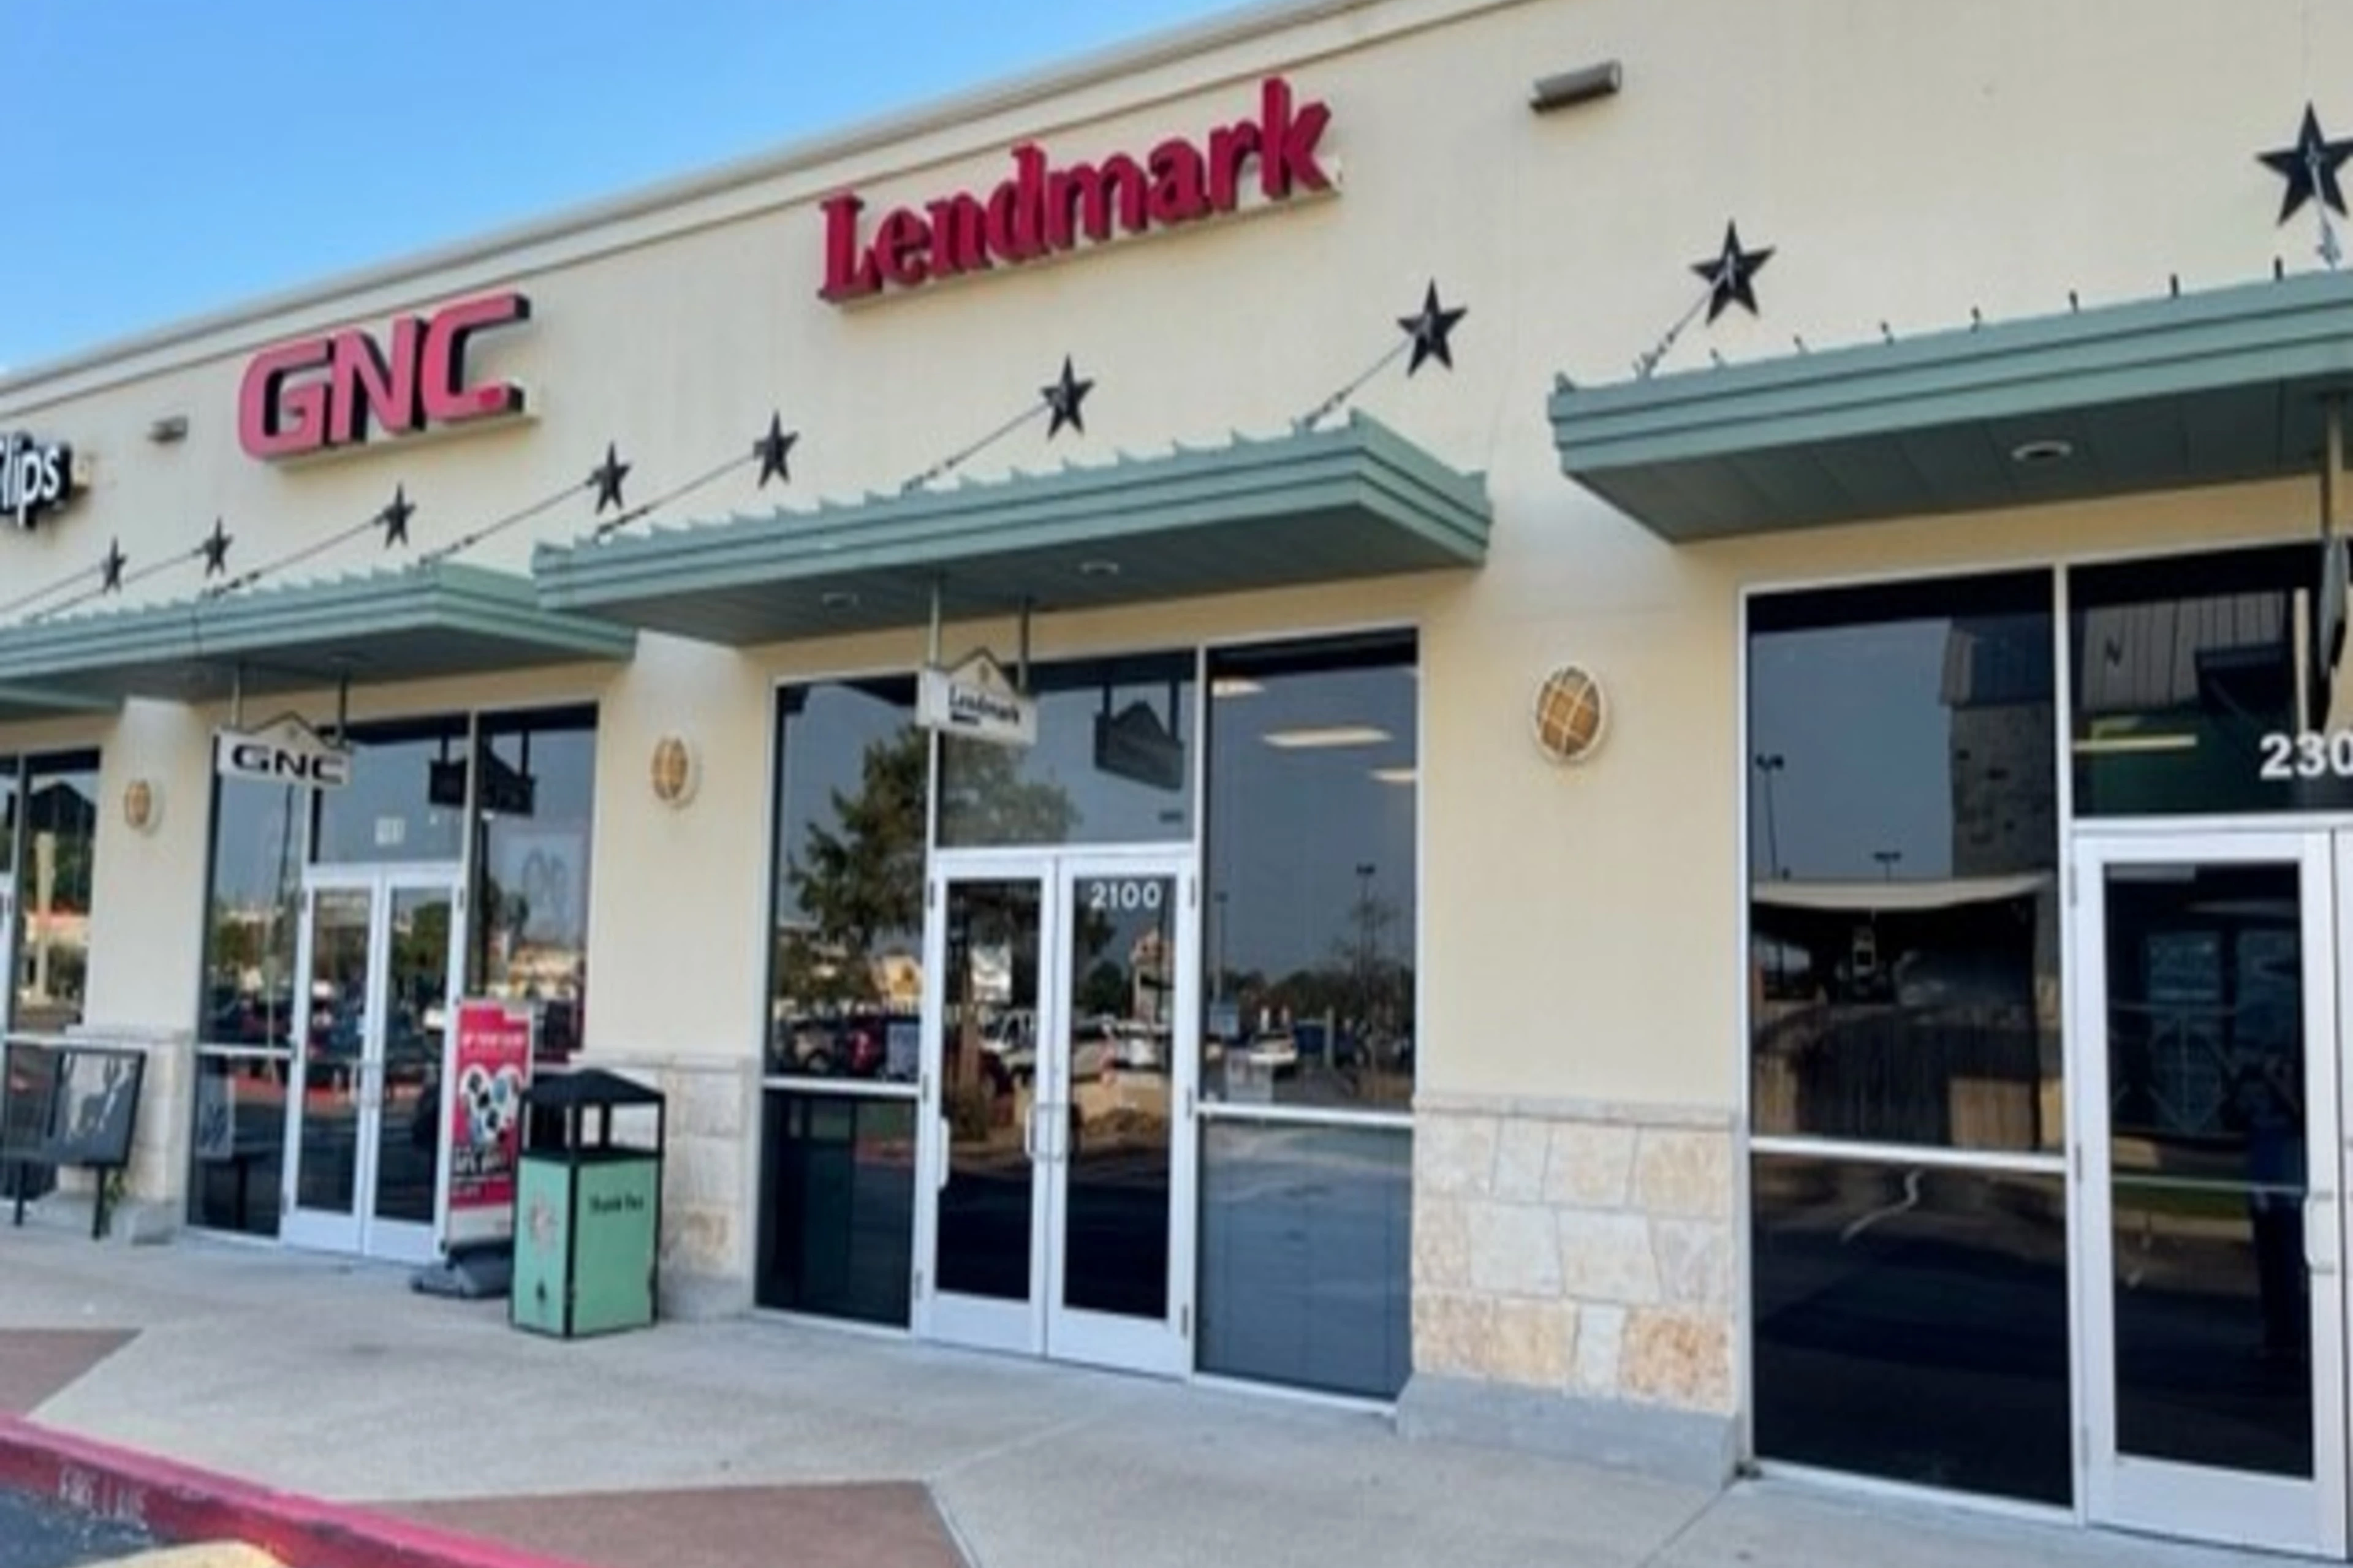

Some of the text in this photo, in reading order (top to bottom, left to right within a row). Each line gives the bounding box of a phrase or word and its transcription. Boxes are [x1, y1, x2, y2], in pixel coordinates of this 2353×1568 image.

[818, 77, 1332, 303] Lendmark
[238, 286, 530, 461] GNC
[0, 430, 64, 529] lips
[231, 743, 344, 784] GNC
[2259, 729, 2353, 779] 230
[1090, 881, 1162, 909] 2100
